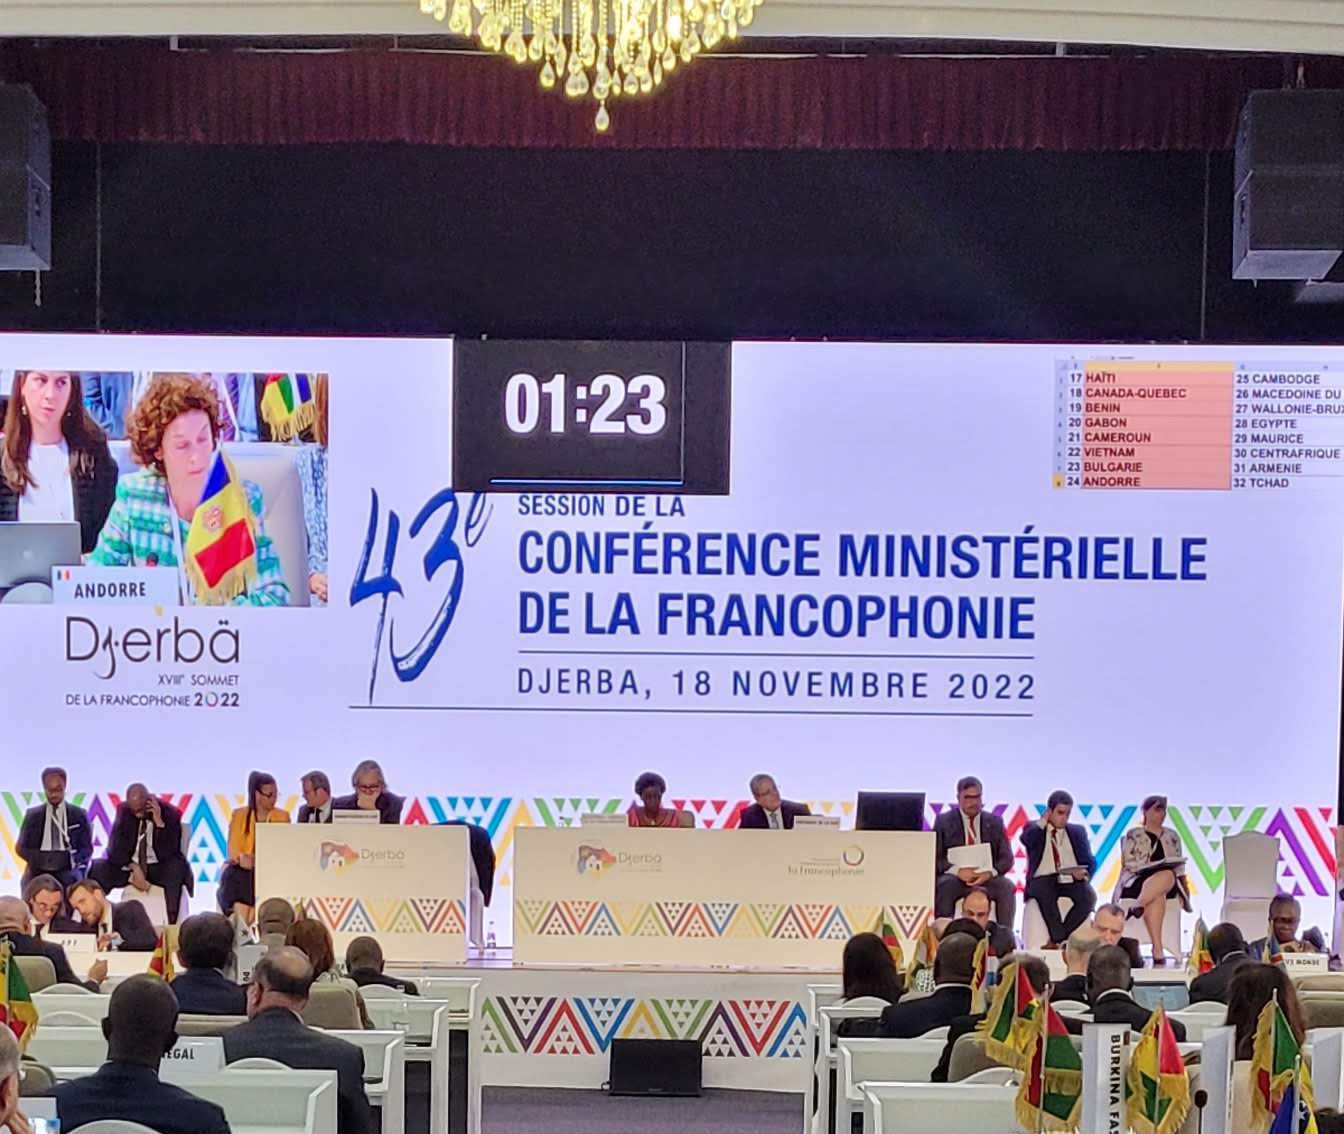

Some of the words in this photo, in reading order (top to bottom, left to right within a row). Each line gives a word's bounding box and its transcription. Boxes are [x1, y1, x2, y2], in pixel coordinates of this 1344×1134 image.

[1070, 374, 1082, 384] 17
[1236, 374, 1249, 384] 25
[1252, 374, 1320, 385] CAMBODGE
[1070, 388, 1082, 399] 18
[1085, 388, 1187, 399] CANADA-QUEBEC
[1236, 389, 1249, 400] 26
[1252, 389, 1322, 400] MACEDOINE
[1325, 389, 1342, 400] DU
[505, 373, 667, 434] 01:23
[1069, 403, 1082, 413] 19
[1085, 403, 1121, 413] BENIN
[1235, 404, 1248, 414] 27
[1068, 418, 1082, 428] 20
[1084, 417, 1127, 428] GABON
[1235, 419, 1248, 429] 28
[1251, 419, 1298, 430] EGYPTE
[1068, 433, 1081, 443] 21
[1084, 432, 1152, 443] CAMEROUN
[1234, 434, 1248, 444] 29
[1250, 434, 1304, 444] MAURICE
[1067, 447, 1081, 457] 22
[1084, 448, 1135, 458] VIETNAM
[1234, 449, 1247, 459] 30
[1250, 449, 1341, 459] CENTRAFRIQUE
[1067, 462, 1080, 472] 23
[1083, 462, 1143, 473] BULGARIE
[1234, 463, 1246, 473] 31
[1249, 463, 1303, 474] ARMENIE
[1066, 477, 1080, 487] 24
[1083, 477, 1141, 487] ANDORRE
[1233, 478, 1246, 488] 32
[1250, 478, 1289, 489] TCHAD
[518, 494, 605, 517] SESSION
[615, 495, 646, 517] DE
[656, 496, 686, 517] LA
[518, 521, 821, 577] CONFÉRENCE
[839, 525, 1208, 581] MINISTÉRIELLE
[74, 582, 146, 599] ANDORRE
[518, 592, 570, 635] DE
[585, 593, 641, 635] LA
[658, 594, 1035, 640] FRANCOPHONIE
[191, 674, 239, 686] SOMMET
[518, 668, 651, 700] DJERBA,
[673, 670, 711, 696] 18
[733, 671, 929, 699] NOVEMBRE
[949, 674, 1035, 700] 2022
[66, 694, 82, 706] DE
[83, 695, 98, 706] LA
[100, 694, 191, 707] FRANCOPHONIE
[194, 691, 240, 708] 2022
[1109, 1034, 1121, 1106] BURKINA
